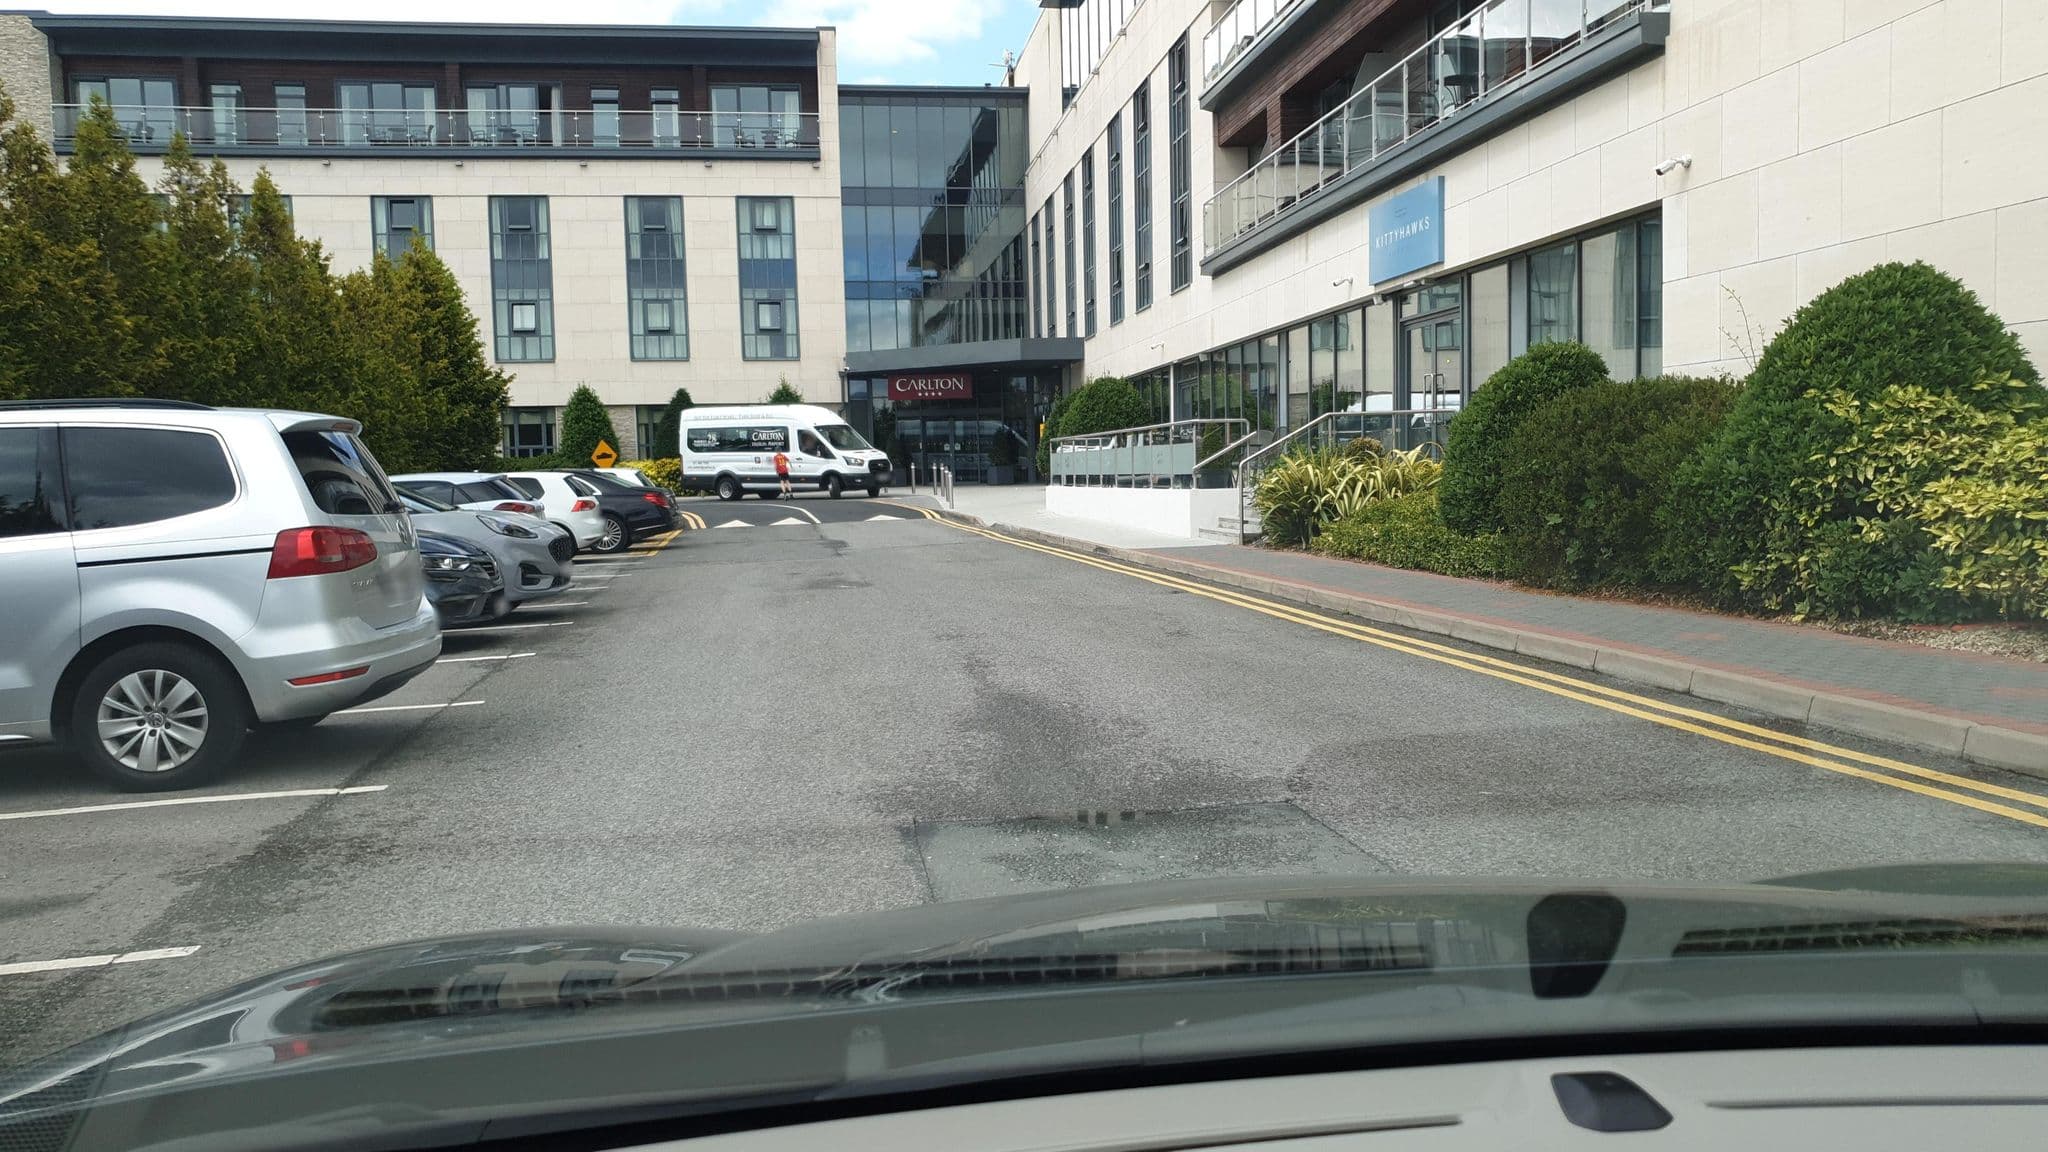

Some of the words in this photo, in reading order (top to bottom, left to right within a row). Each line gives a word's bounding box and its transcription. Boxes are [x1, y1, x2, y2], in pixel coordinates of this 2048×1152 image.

[1375, 216, 1430, 249] KITTYHAWKS
[895, 377, 964, 392] CARLTON
[752, 431, 784, 441] CARLTON
